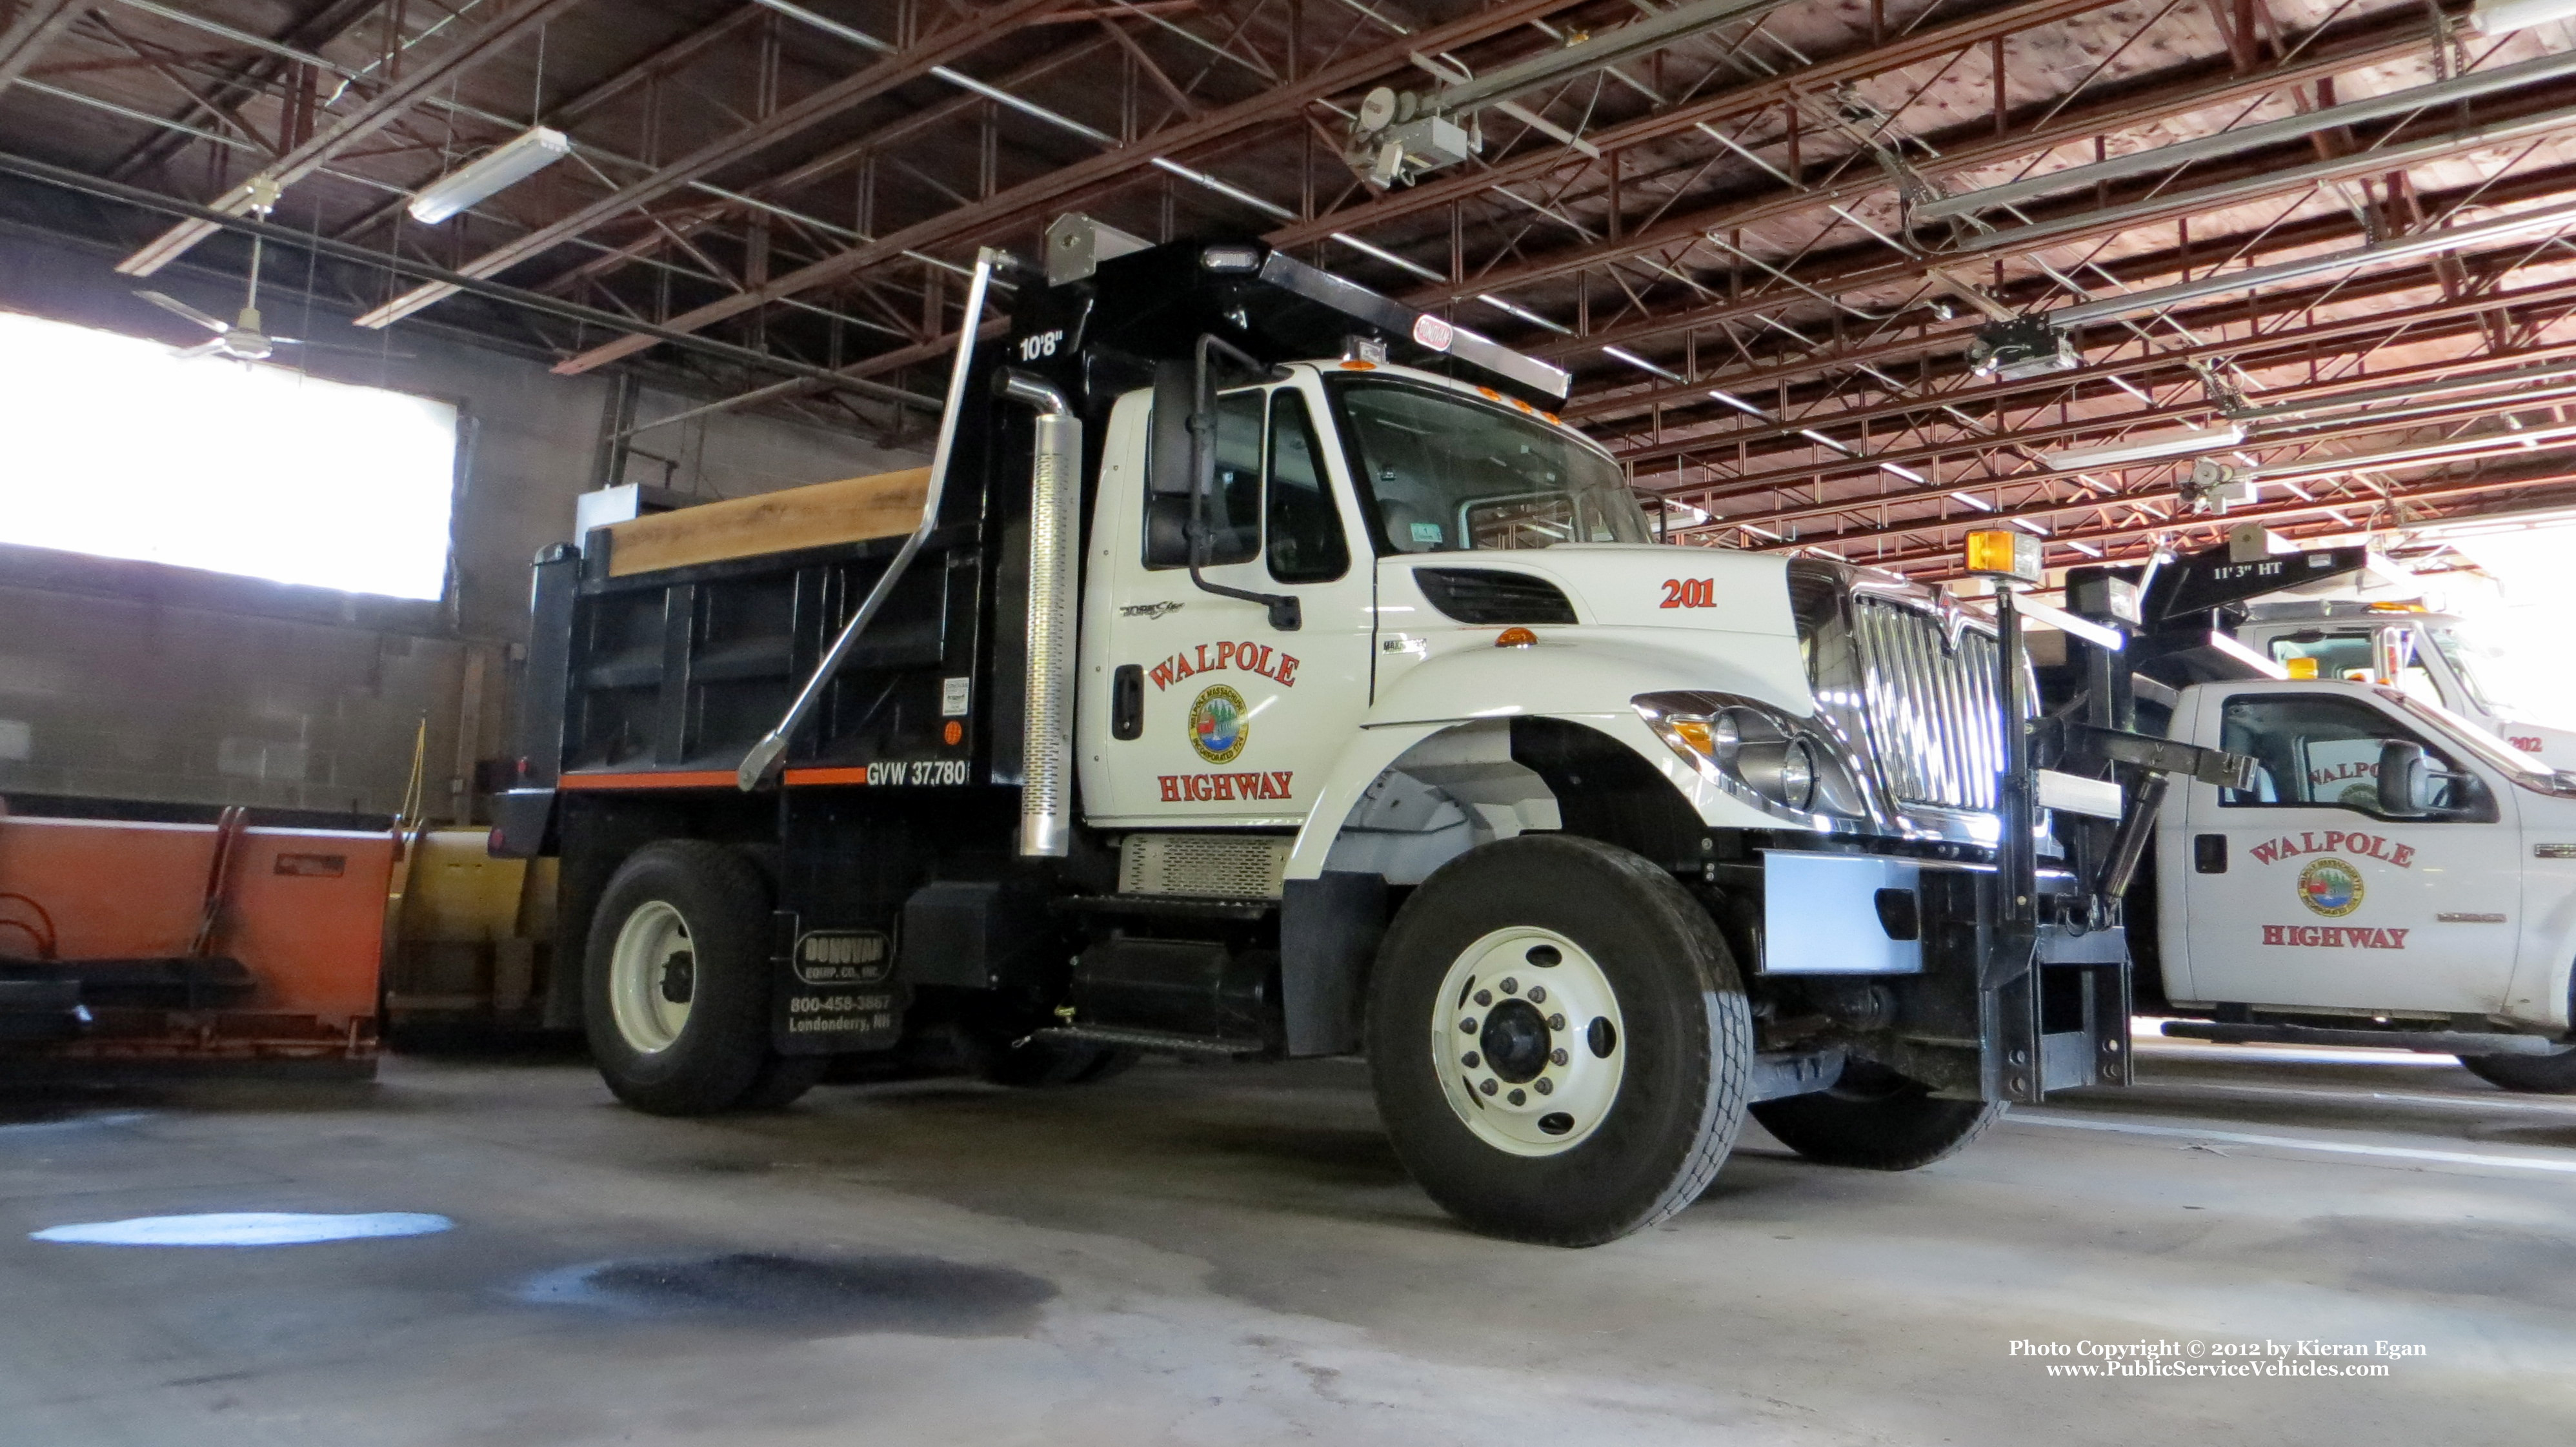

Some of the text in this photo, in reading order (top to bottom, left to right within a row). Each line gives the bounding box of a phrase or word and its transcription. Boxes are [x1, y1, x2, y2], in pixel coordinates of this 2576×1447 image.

[1020, 330, 1063, 361] 10'8"
[2214, 562, 2282, 580] 11' 3" HT
[1659, 578, 1717, 609] 201
[1149, 641, 1300, 692] WALPOLE
[1192, 737, 1234, 762] INCORPORATED
[2508, 736, 2543, 753] 202
[867, 760, 966, 787] GVW 37,780
[1158, 771, 1293, 802] HIGHWAY
[2308, 762, 2380, 785] WALPO
[2249, 830, 2416, 868] WALPOLE
[805, 937, 884, 964] DONOVAN
[2262, 925, 2410, 949] HIGHWAY
